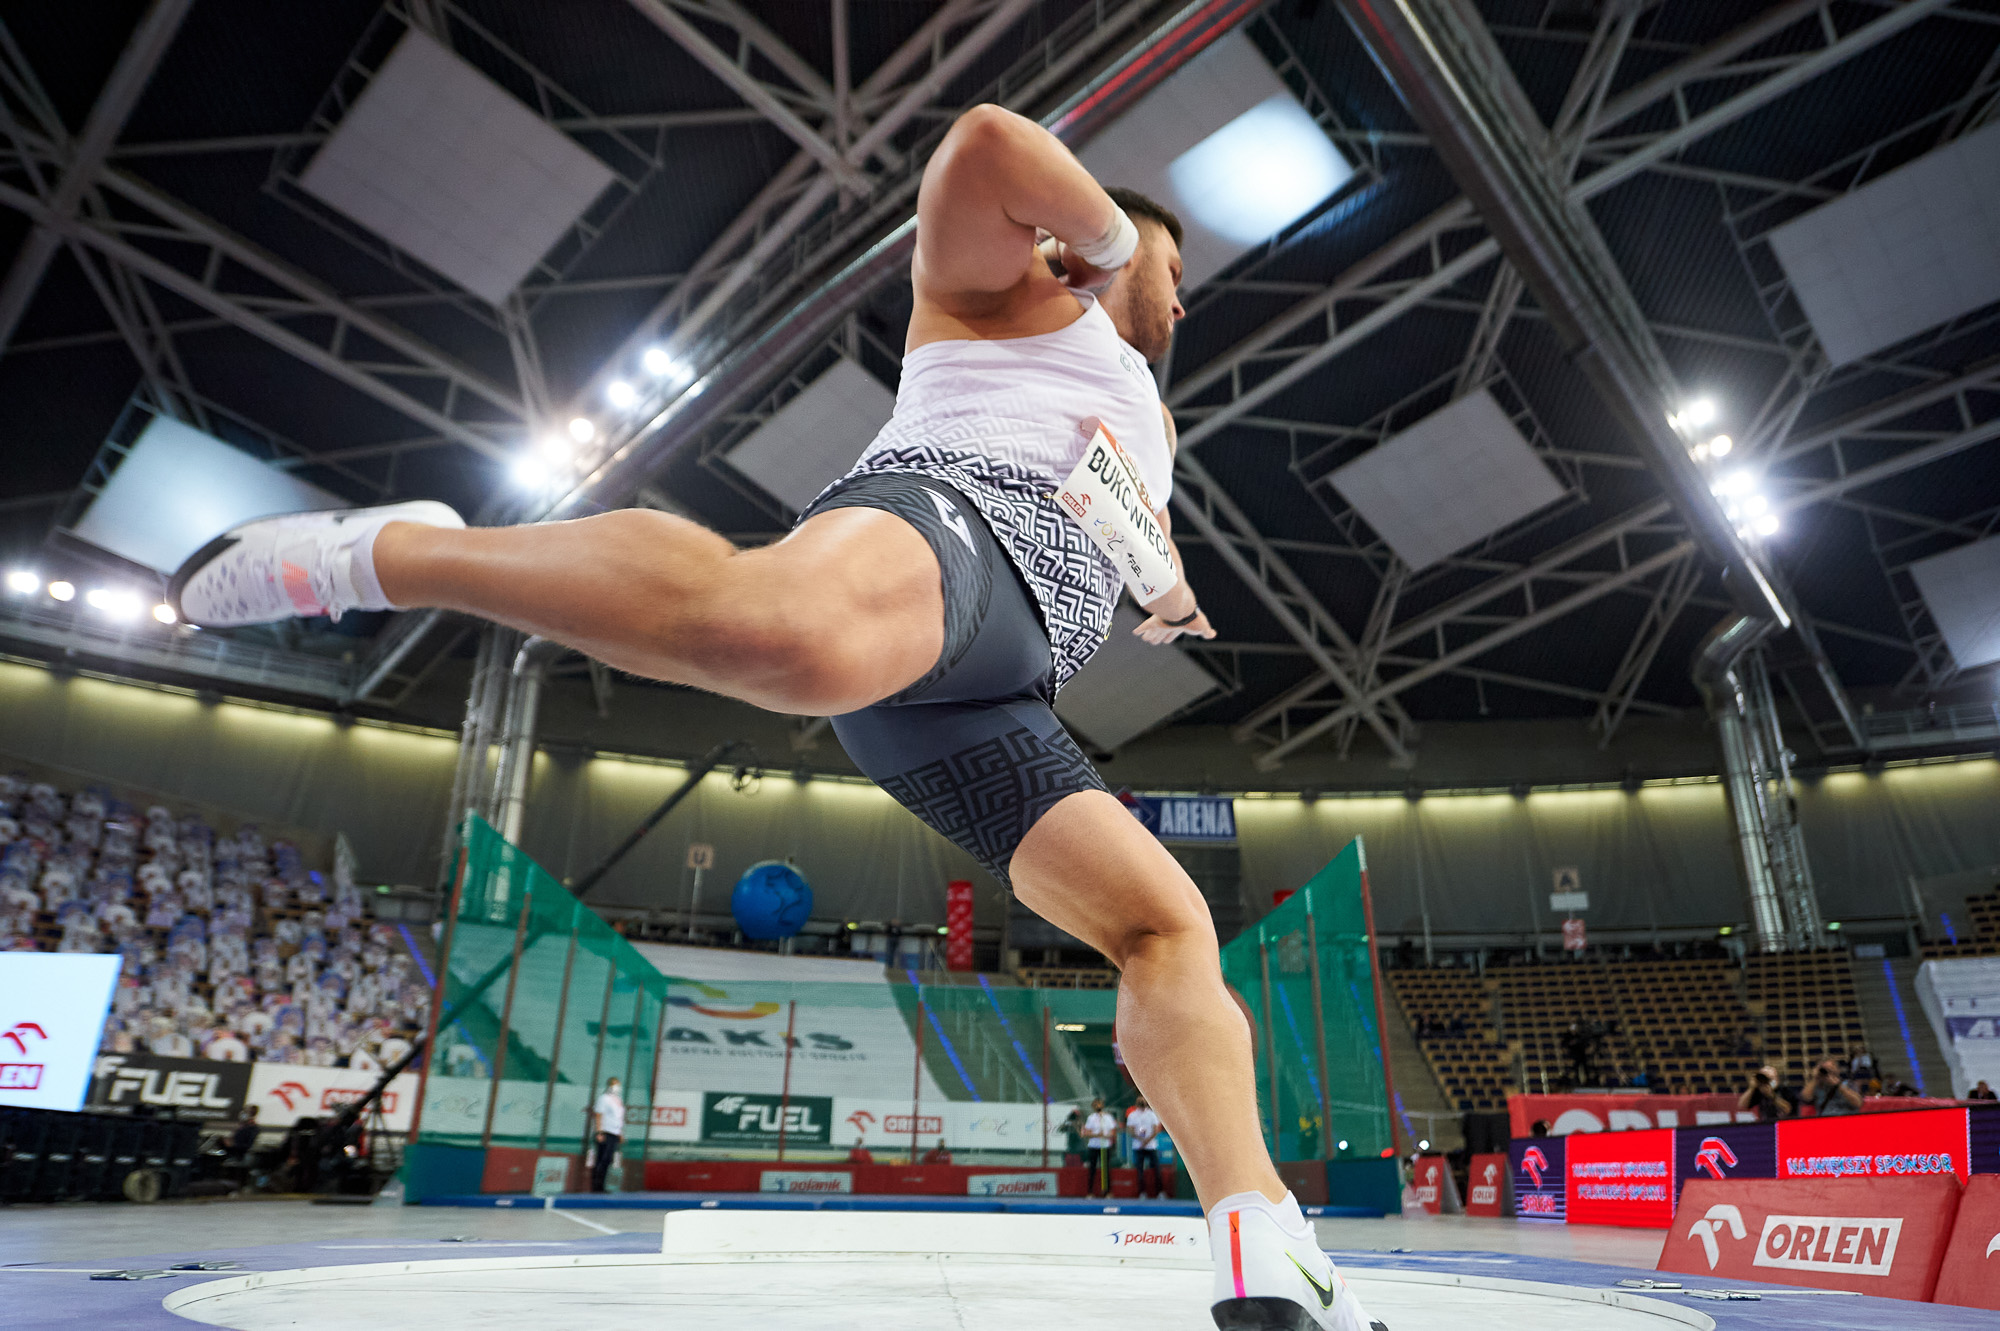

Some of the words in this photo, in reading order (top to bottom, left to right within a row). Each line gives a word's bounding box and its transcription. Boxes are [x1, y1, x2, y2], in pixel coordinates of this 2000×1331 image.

[1159, 800, 1233, 835] ARENA
[109, 1067, 233, 1108] FUEL
[738, 1104, 823, 1132] FUEL
[996, 1178, 1047, 1194] polanik
[1124, 1231, 1175, 1246] polanik
[1765, 1222, 1890, 1266] ORLEN
